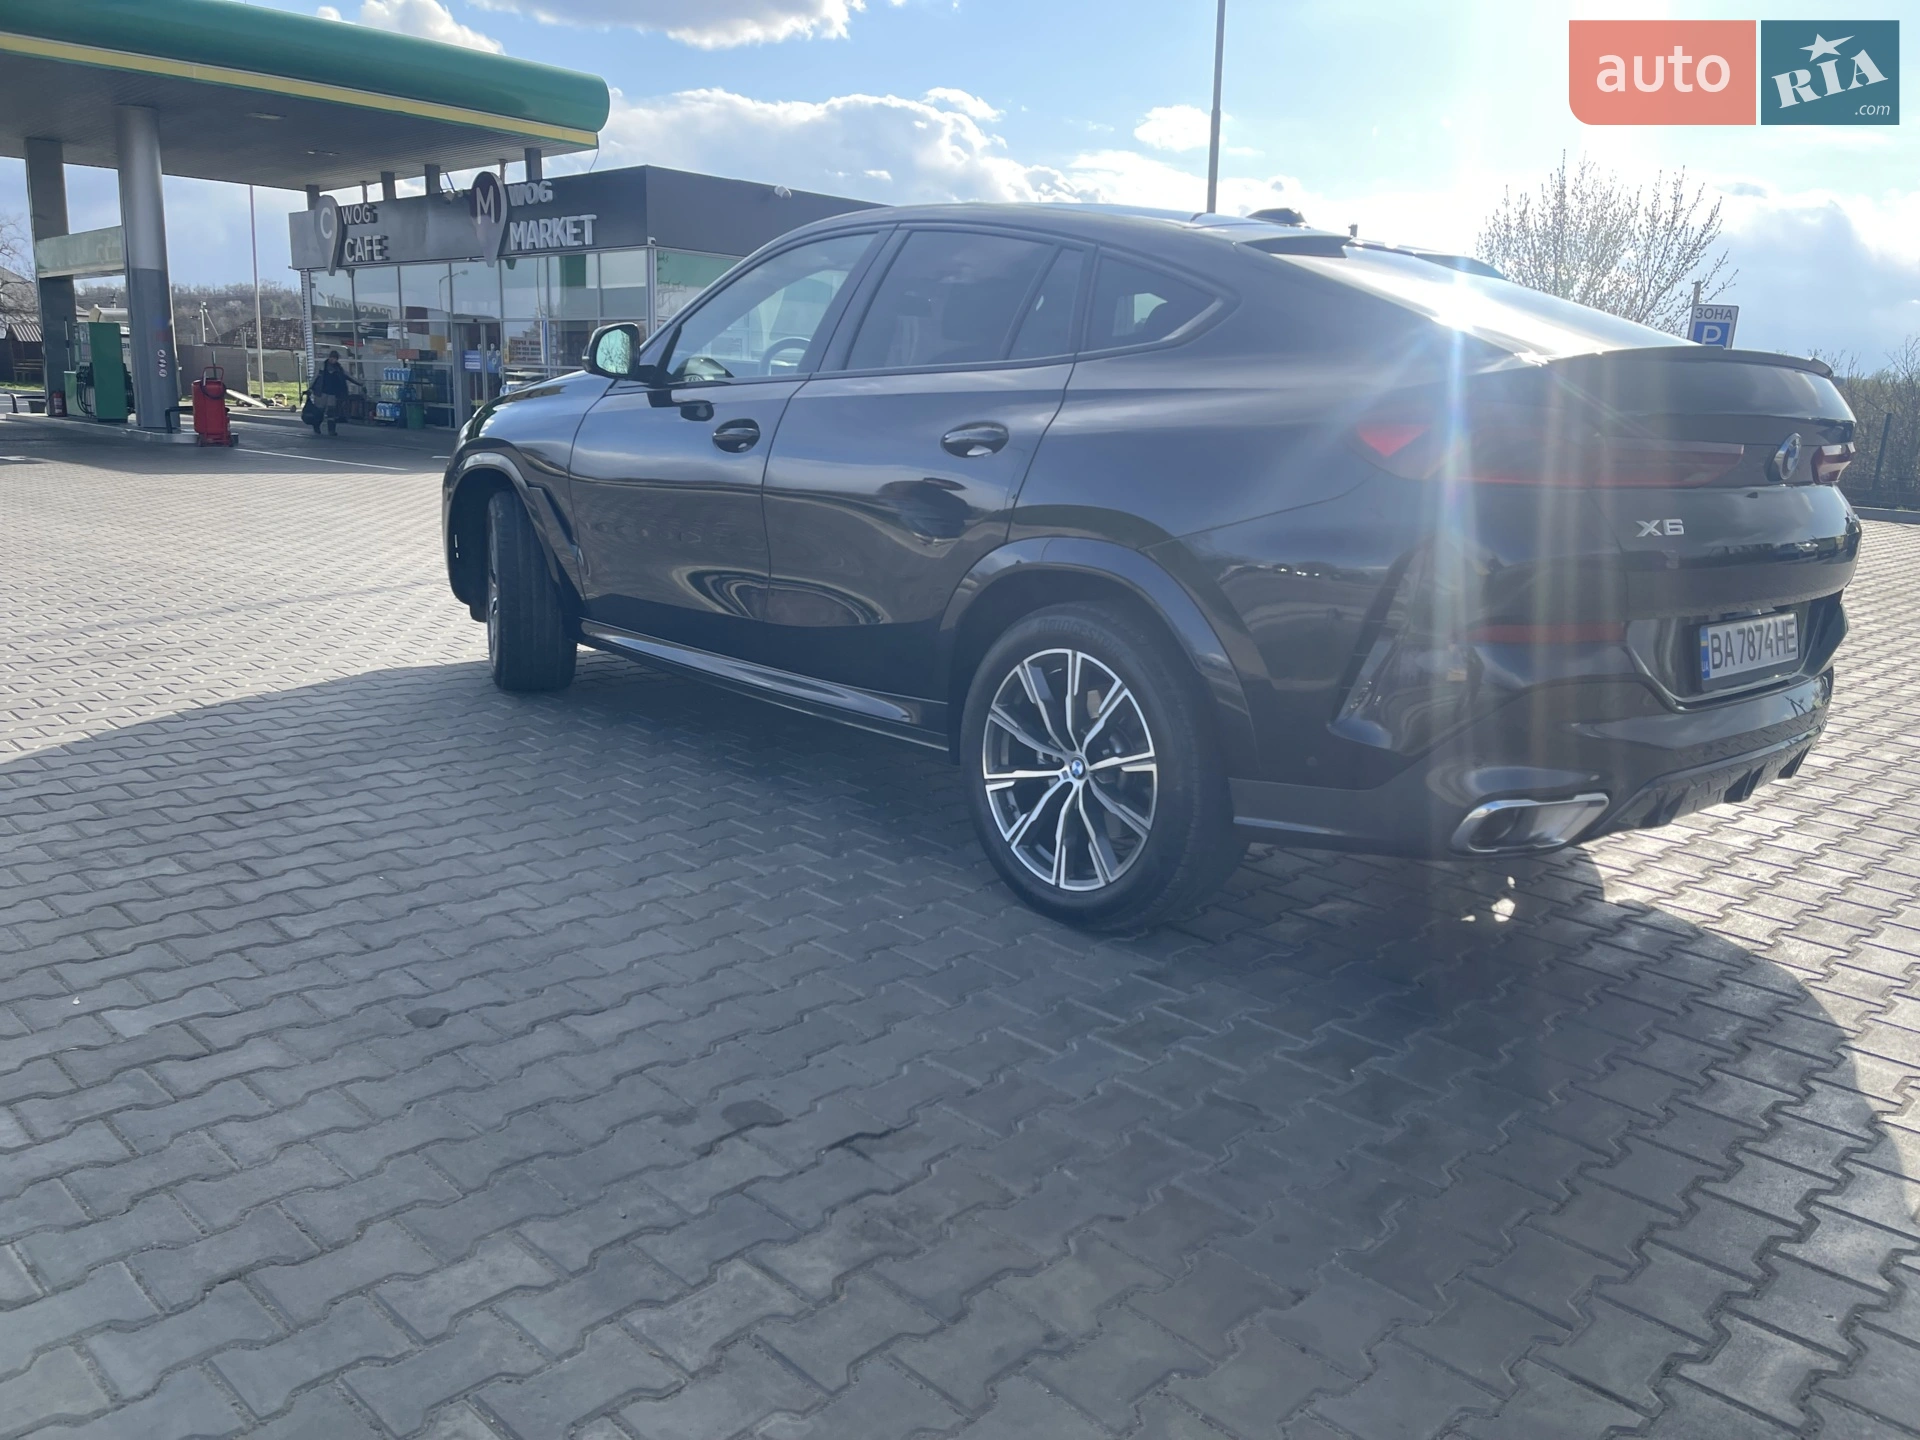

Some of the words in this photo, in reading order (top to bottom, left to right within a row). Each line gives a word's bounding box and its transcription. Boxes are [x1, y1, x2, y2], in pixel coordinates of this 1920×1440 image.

[476, 185, 495, 224] M
[508, 180, 553, 207] WOG
[319, 207, 333, 239] C
[341, 205, 372, 224] WOG
[509, 214, 597, 251] MARKET
[344, 234, 385, 262] CAFE
[1695, 307, 1733, 321] ЗОНА
[1635, 518, 1685, 538] X6
